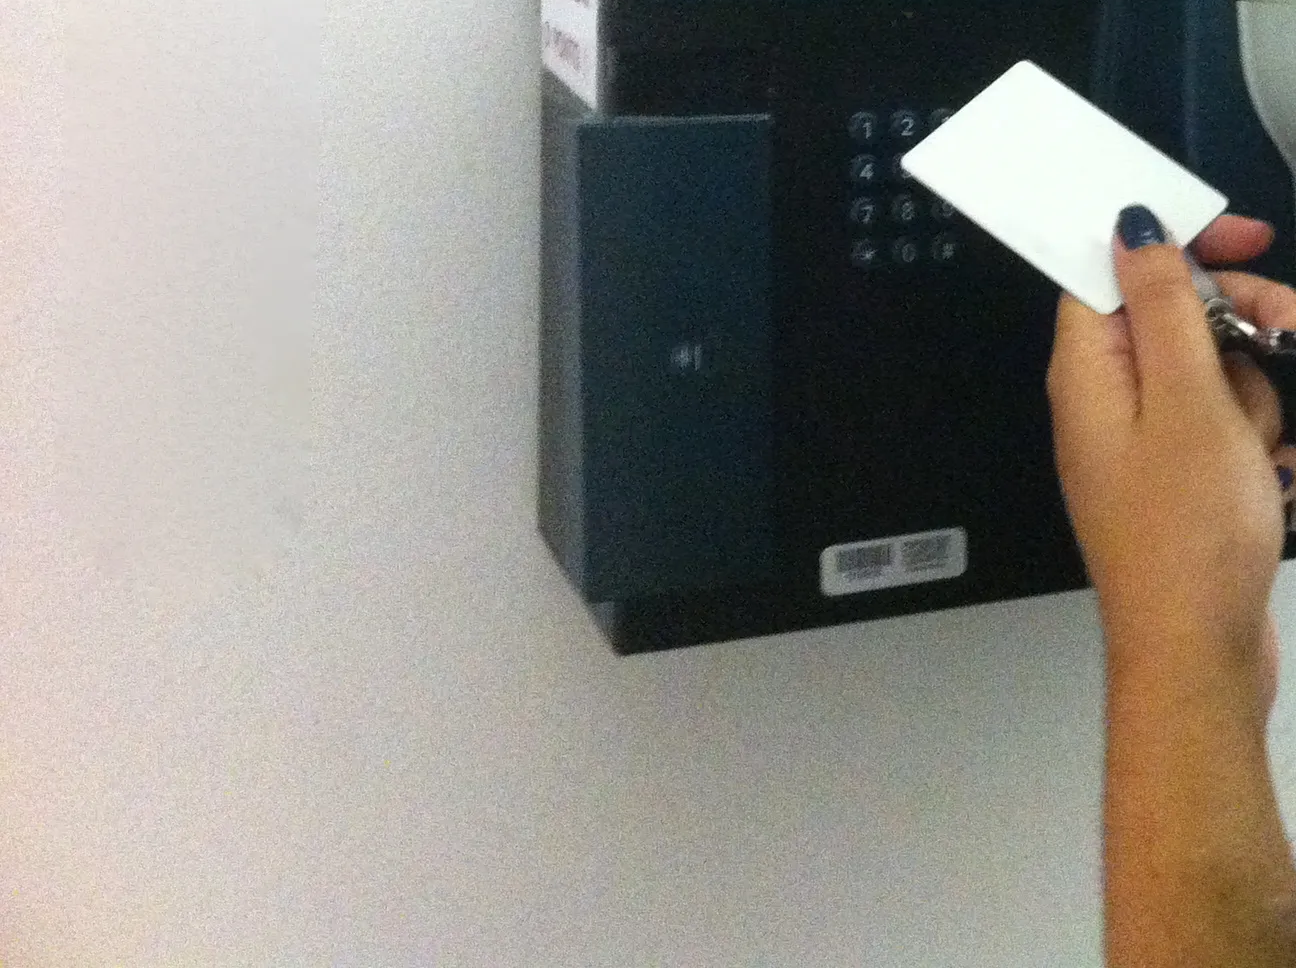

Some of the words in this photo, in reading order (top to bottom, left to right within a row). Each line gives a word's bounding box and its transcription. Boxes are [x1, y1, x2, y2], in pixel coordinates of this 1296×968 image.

[901, 118, 916, 136] 2
[860, 164, 874, 180] 4
[861, 205, 874, 223] 7
